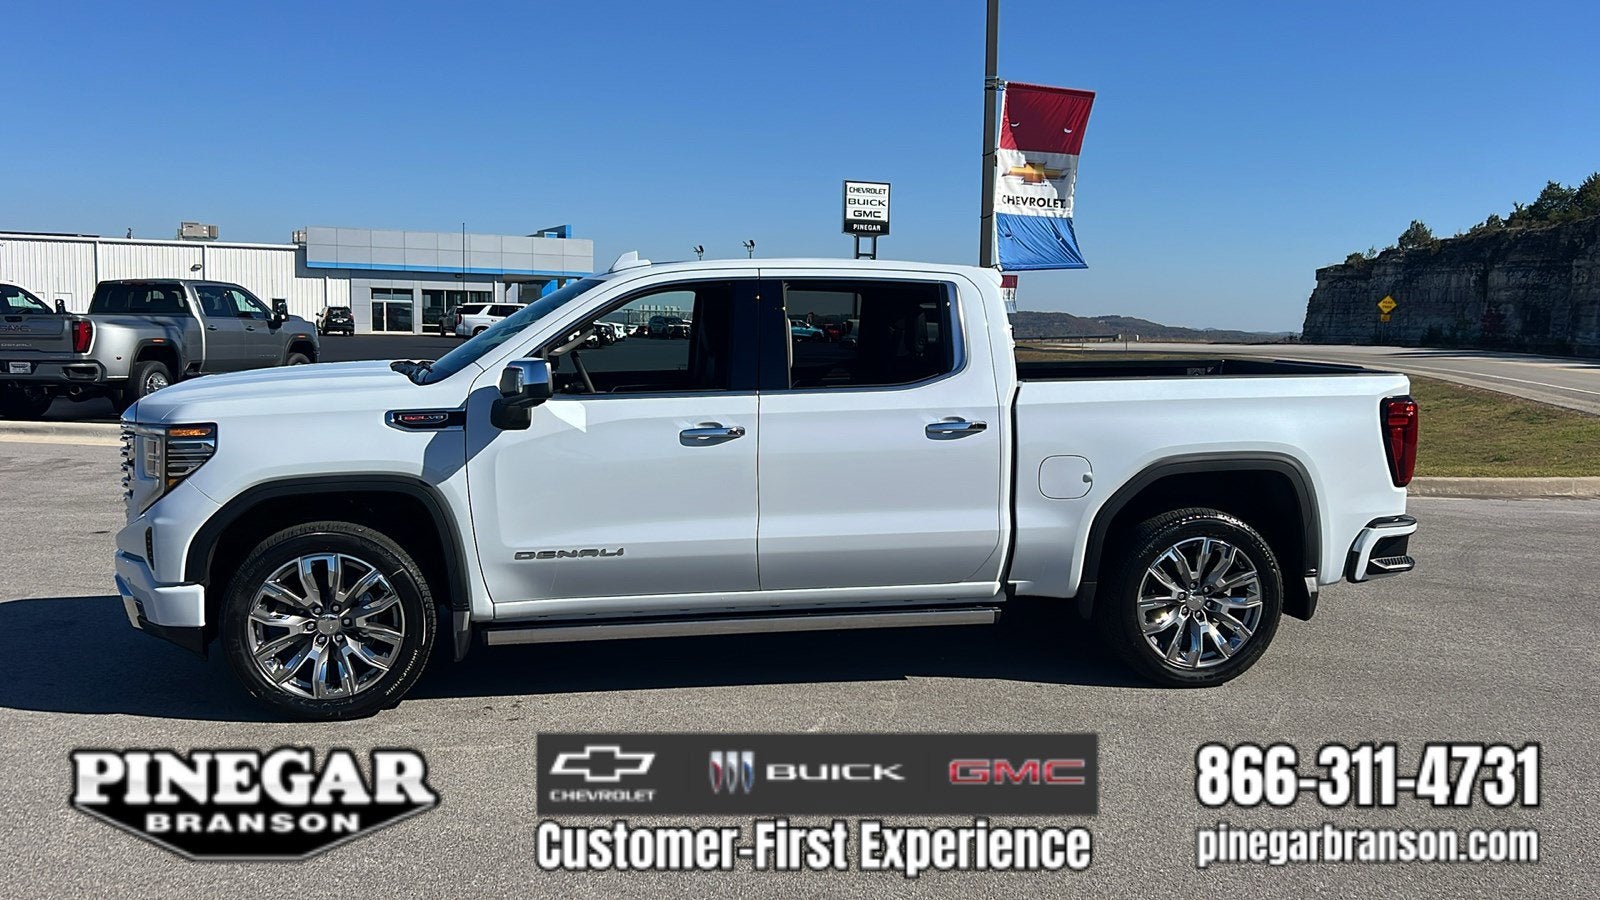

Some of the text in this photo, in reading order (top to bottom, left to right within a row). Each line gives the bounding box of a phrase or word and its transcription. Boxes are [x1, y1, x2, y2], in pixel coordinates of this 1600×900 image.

[849, 187, 887, 195] CHEVROLET
[848, 198, 886, 207] BUICK
[1002, 194, 1065, 209] CHEVROLET
[853, 210, 882, 218] GMC
[853, 223, 881, 231] PINEGAR
[514, 547, 625, 561] DENALI
